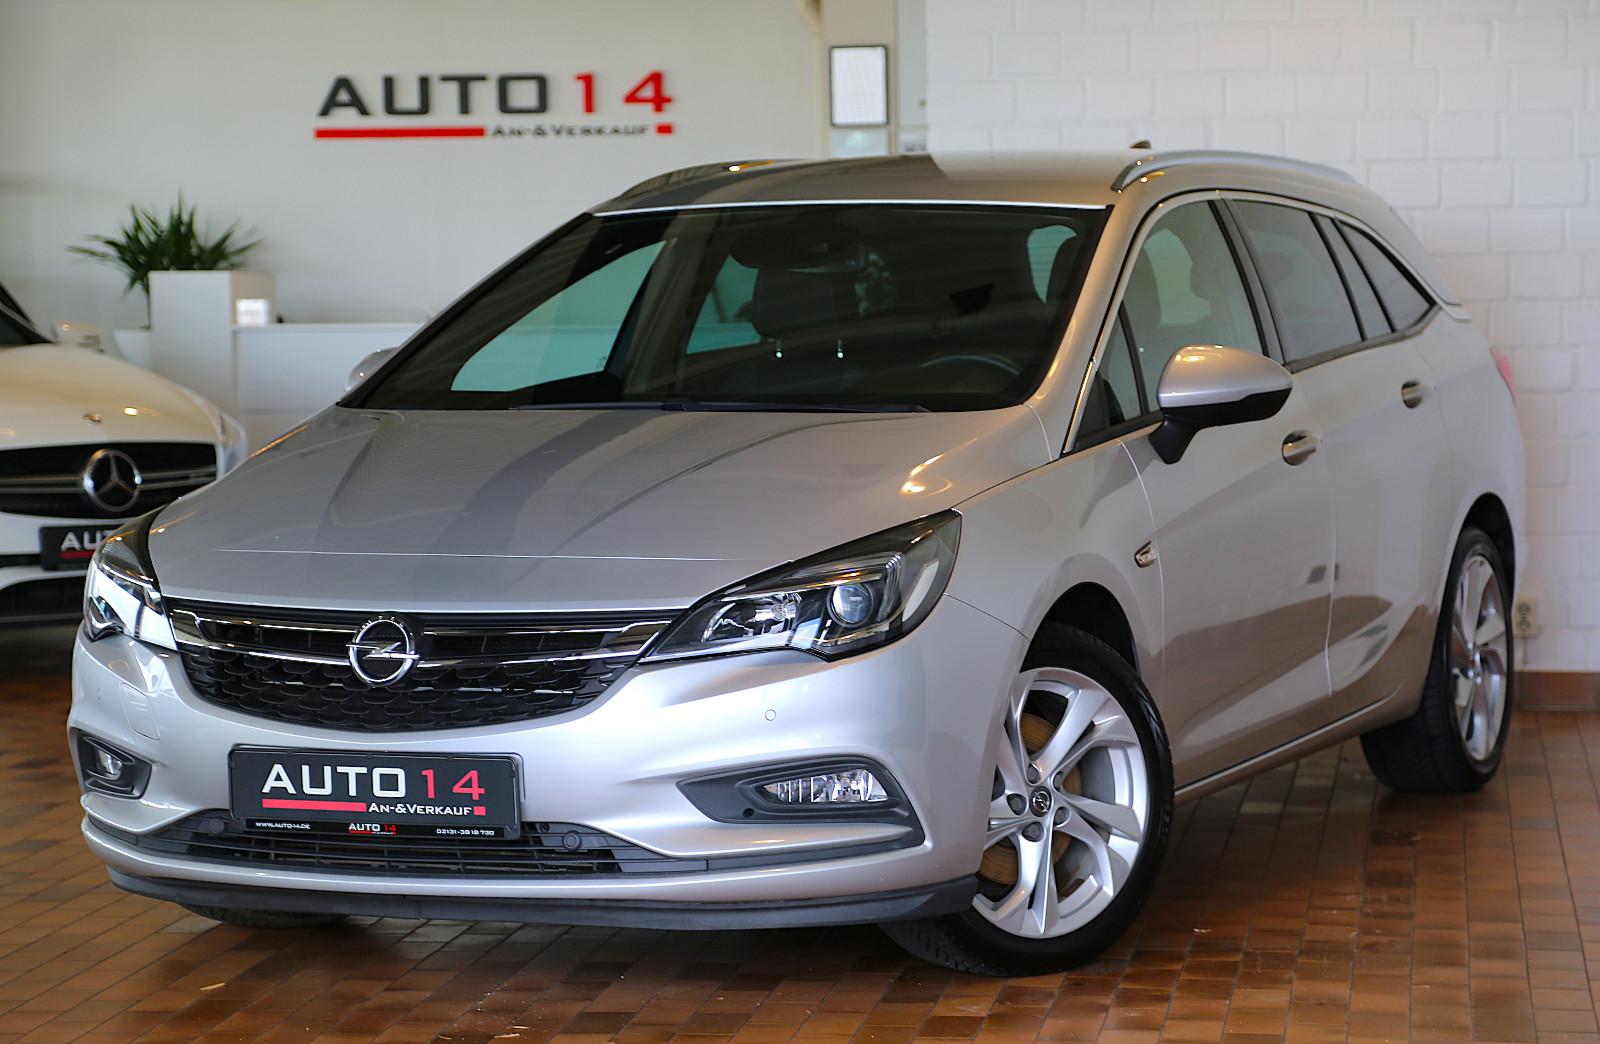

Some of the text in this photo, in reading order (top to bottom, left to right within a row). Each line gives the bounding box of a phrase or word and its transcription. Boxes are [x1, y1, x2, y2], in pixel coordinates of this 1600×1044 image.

[317, 70, 674, 116] AUTO 14
[262, 763, 486, 800] AUTO 14
[348, 823, 397, 832] AUTO 14
